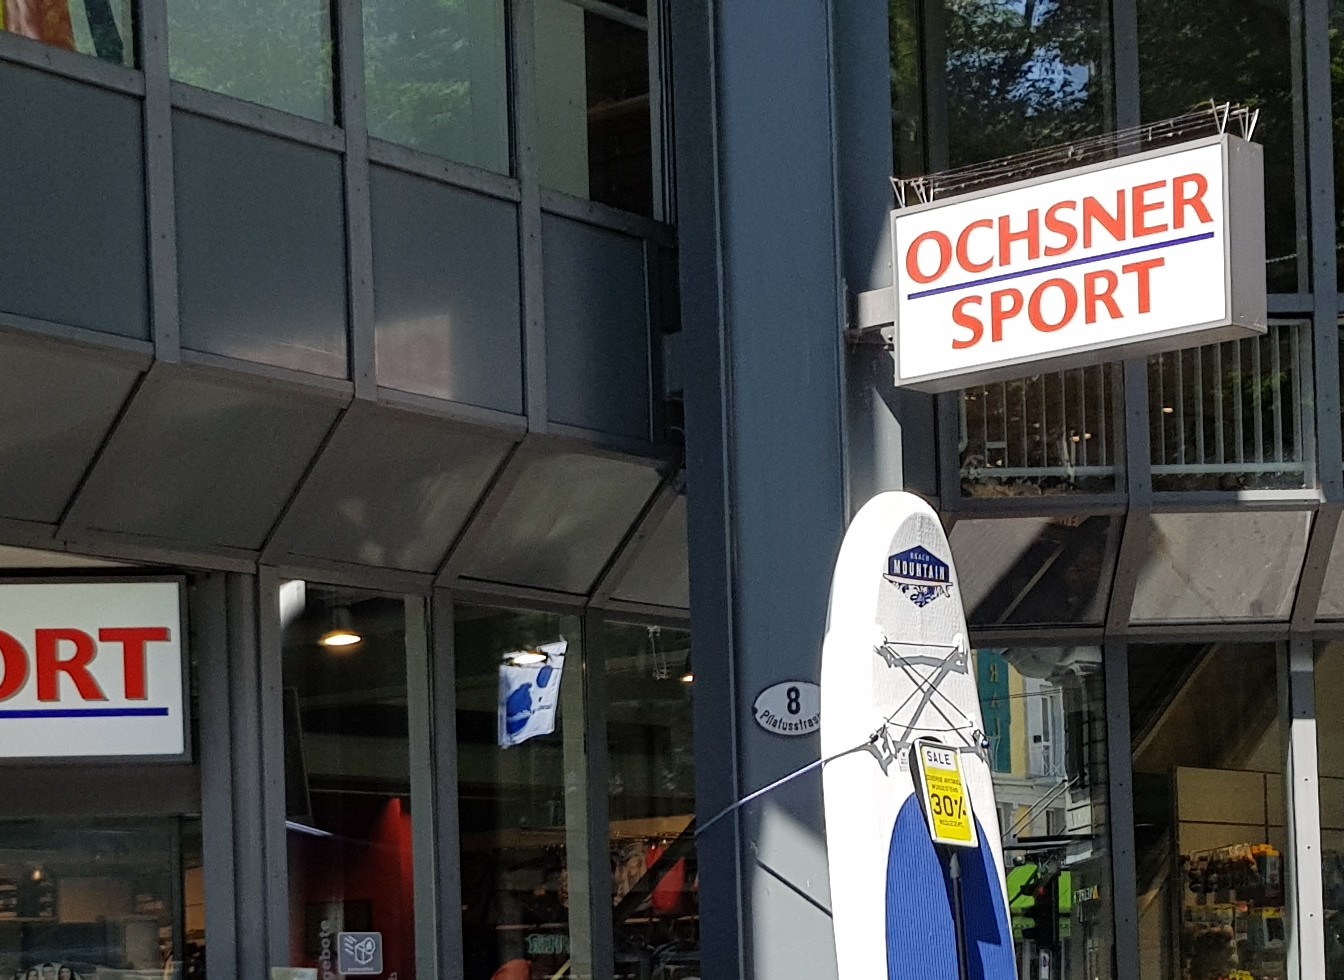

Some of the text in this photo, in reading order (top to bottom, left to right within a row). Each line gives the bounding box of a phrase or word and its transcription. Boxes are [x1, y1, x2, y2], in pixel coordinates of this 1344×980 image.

[906, 173, 1214, 284] OCHSNER
[951, 257, 1165, 349] SPORT
[893, 559, 945, 581] MOUNTAIN
[786, 686, 801, 715] 8
[926, 750, 952, 766] SALE
[931, 792, 967, 820] 30%
